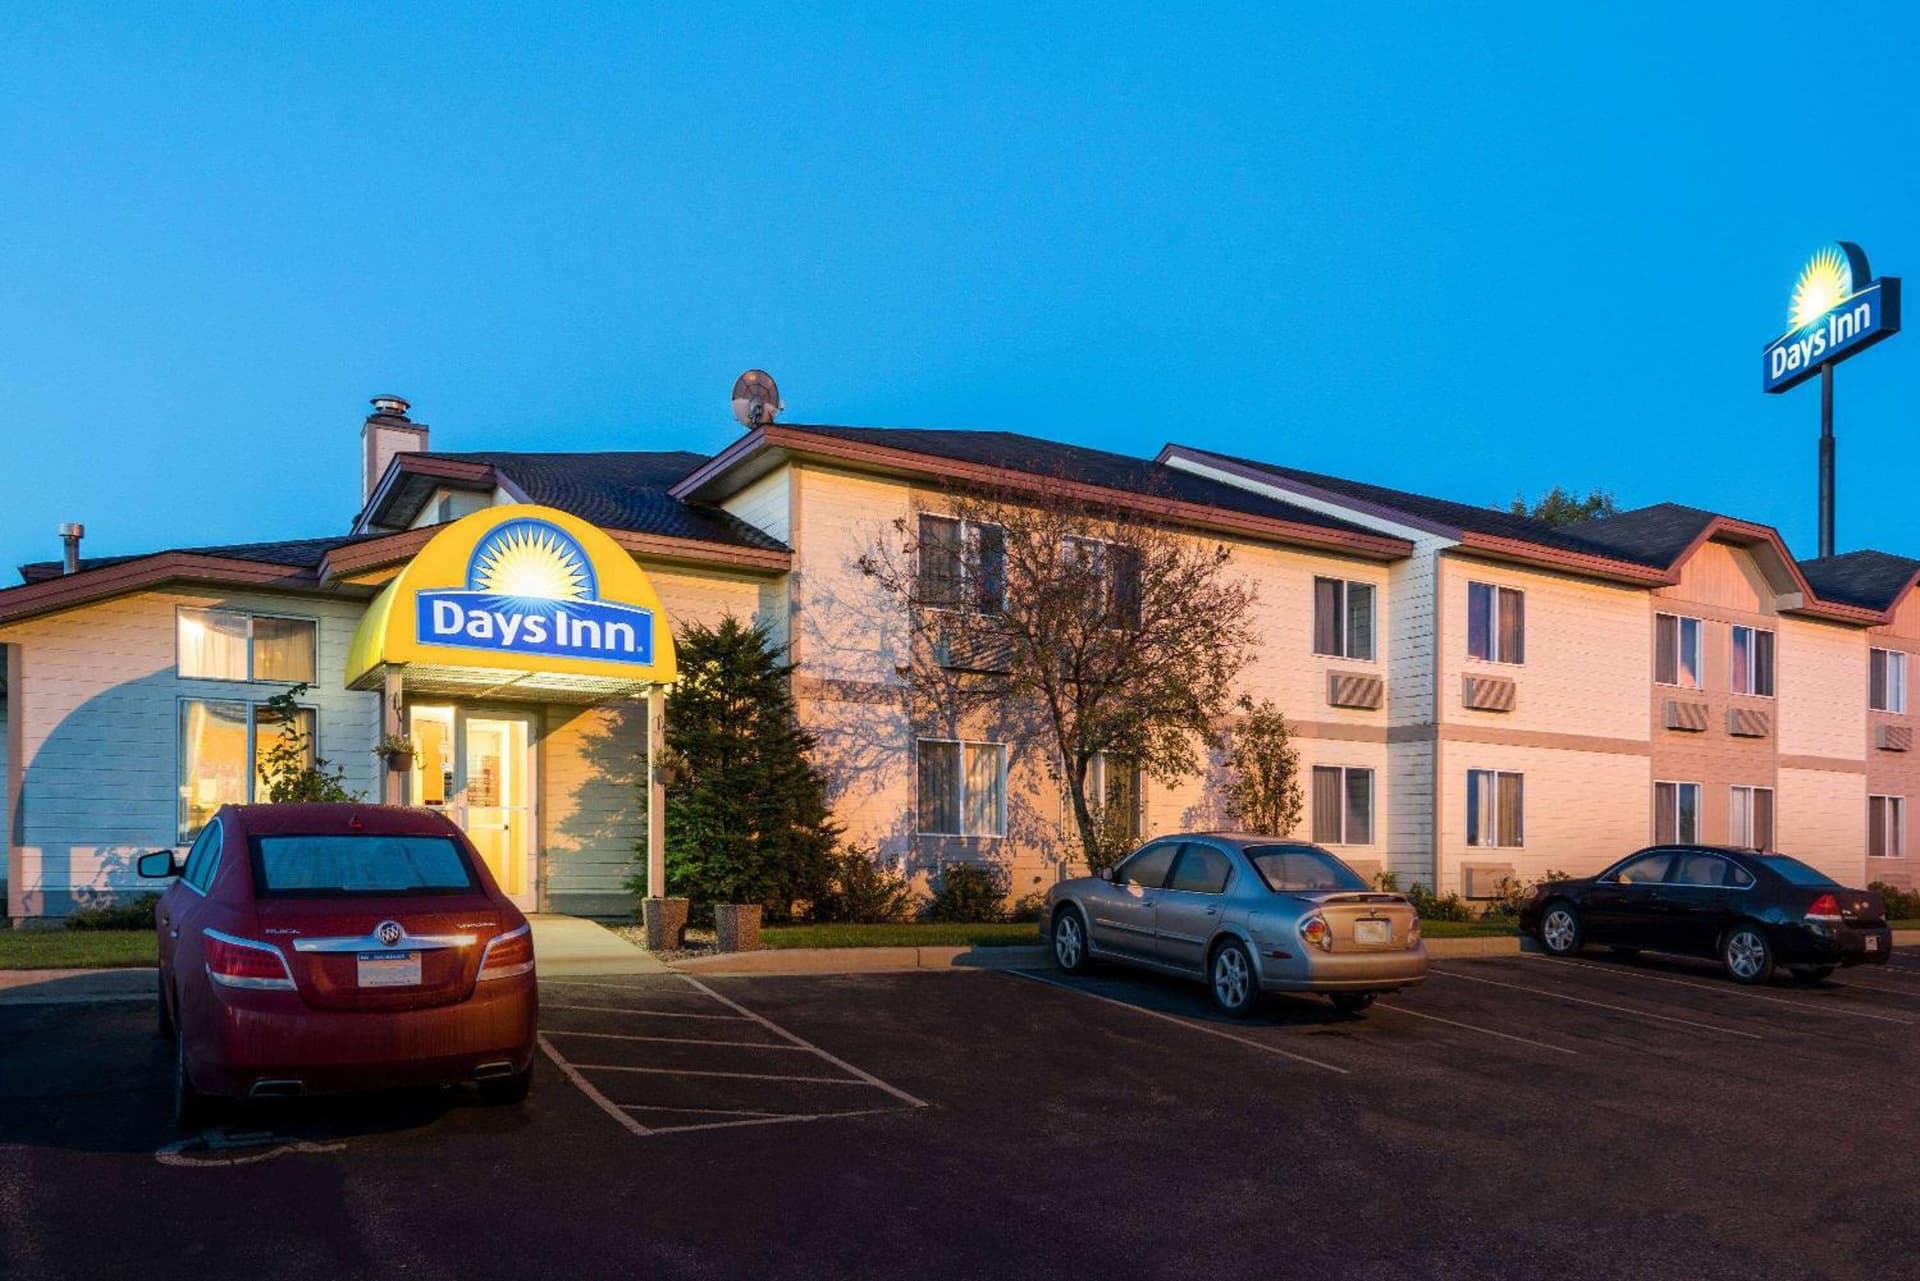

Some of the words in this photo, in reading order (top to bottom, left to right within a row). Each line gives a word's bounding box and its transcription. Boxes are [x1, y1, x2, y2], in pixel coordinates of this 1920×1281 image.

[1771, 327, 1826, 380] Days
[1829, 302, 1870, 348] Inn
[433, 599, 547, 646] Days
[556, 610, 635, 653] Inn
